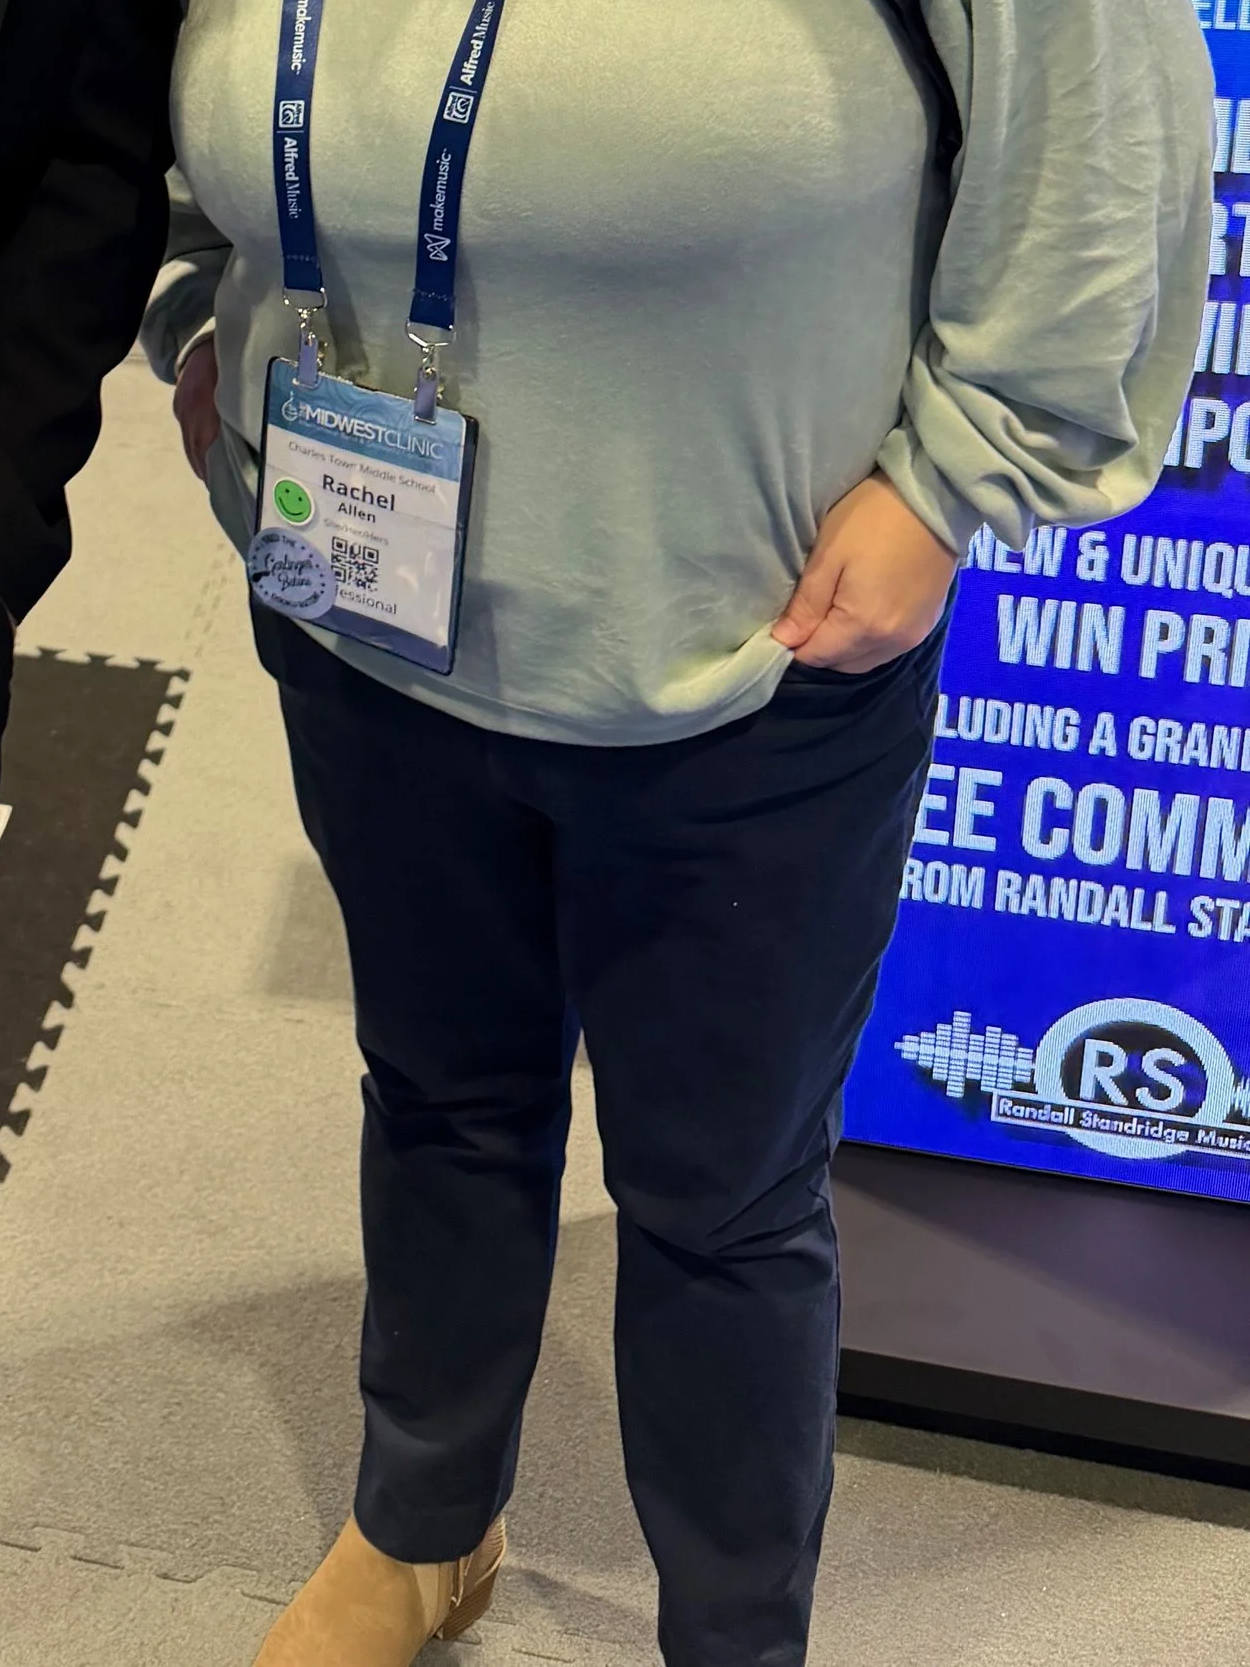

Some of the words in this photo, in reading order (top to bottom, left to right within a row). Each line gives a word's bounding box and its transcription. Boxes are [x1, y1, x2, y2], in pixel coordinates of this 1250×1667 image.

[433, 150, 451, 231] makemusic
[288, 441, 327, 462] Charles
[359, 464, 397, 482] Middle
[398, 475, 436, 493] School
[322, 474, 395, 511] Rachel
[338, 502, 376, 524] Allen
[966, 522, 1067, 578] NEW
[1076, 530, 1110, 583] &
[997, 594, 1126, 675] WIN
[934, 693, 1081, 752] LUDING
[1088, 711, 1117, 757] A
[912, 763, 1003, 852] EE
[995, 869, 1177, 934] RANDALL
[1079, 1038, 1186, 1111] RS
[999, 1097, 1074, 1125] Randall
[1079, 1109, 1189, 1144] Standridge
